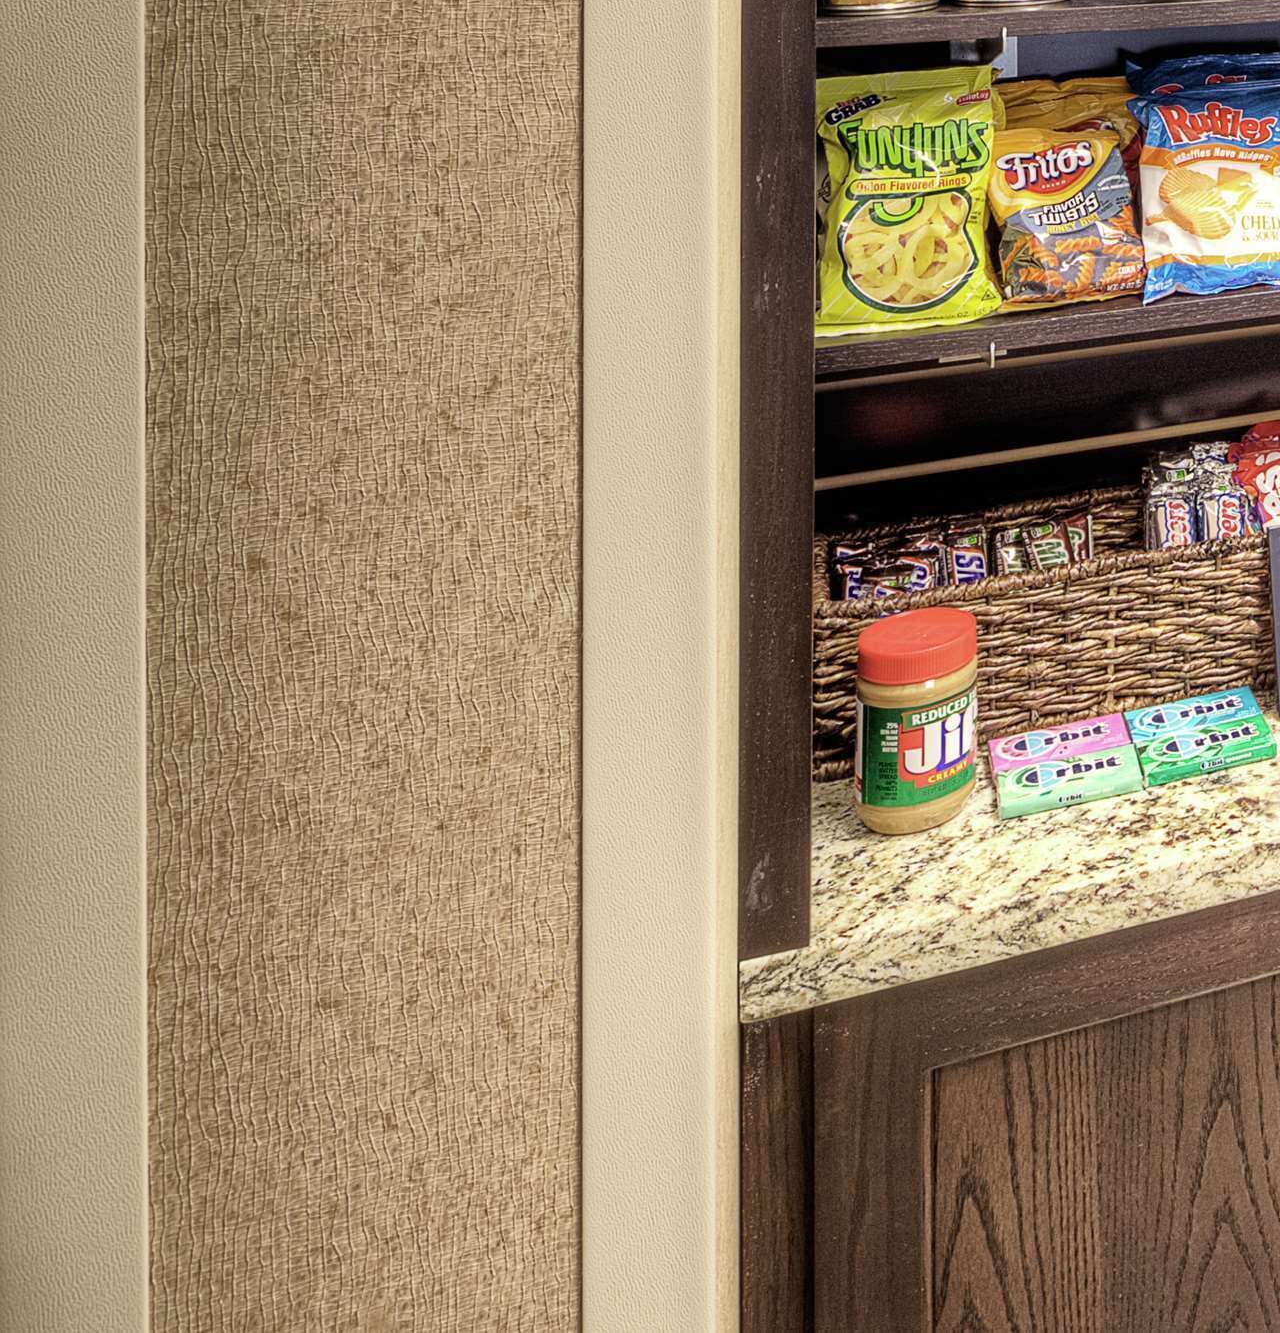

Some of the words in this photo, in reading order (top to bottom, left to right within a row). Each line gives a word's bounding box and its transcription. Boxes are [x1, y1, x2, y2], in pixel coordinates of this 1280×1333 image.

[824, 93, 880, 126] GRAB
[1157, 102, 1276, 145] Ruffles
[838, 118, 990, 222] FUNYUNS
[996, 141, 1093, 192] Fritos
[1214, 146, 1236, 158] Have
[890, 178, 934, 191] Flavored
[937, 175, 967, 187] Rings
[1029, 193, 1099, 226] TWISTS
[1043, 192, 1084, 214] FLAVOR
[912, 696, 967, 726] REDUCED
[1150, 695, 1242, 731] Orbit
[904, 700, 977, 775] Jif
[1013, 720, 1111, 757] Orbit
[1163, 723, 1257, 759] Orbit
[927, 761, 968, 784] CREAMY
[1024, 754, 1122, 792] Orbit
